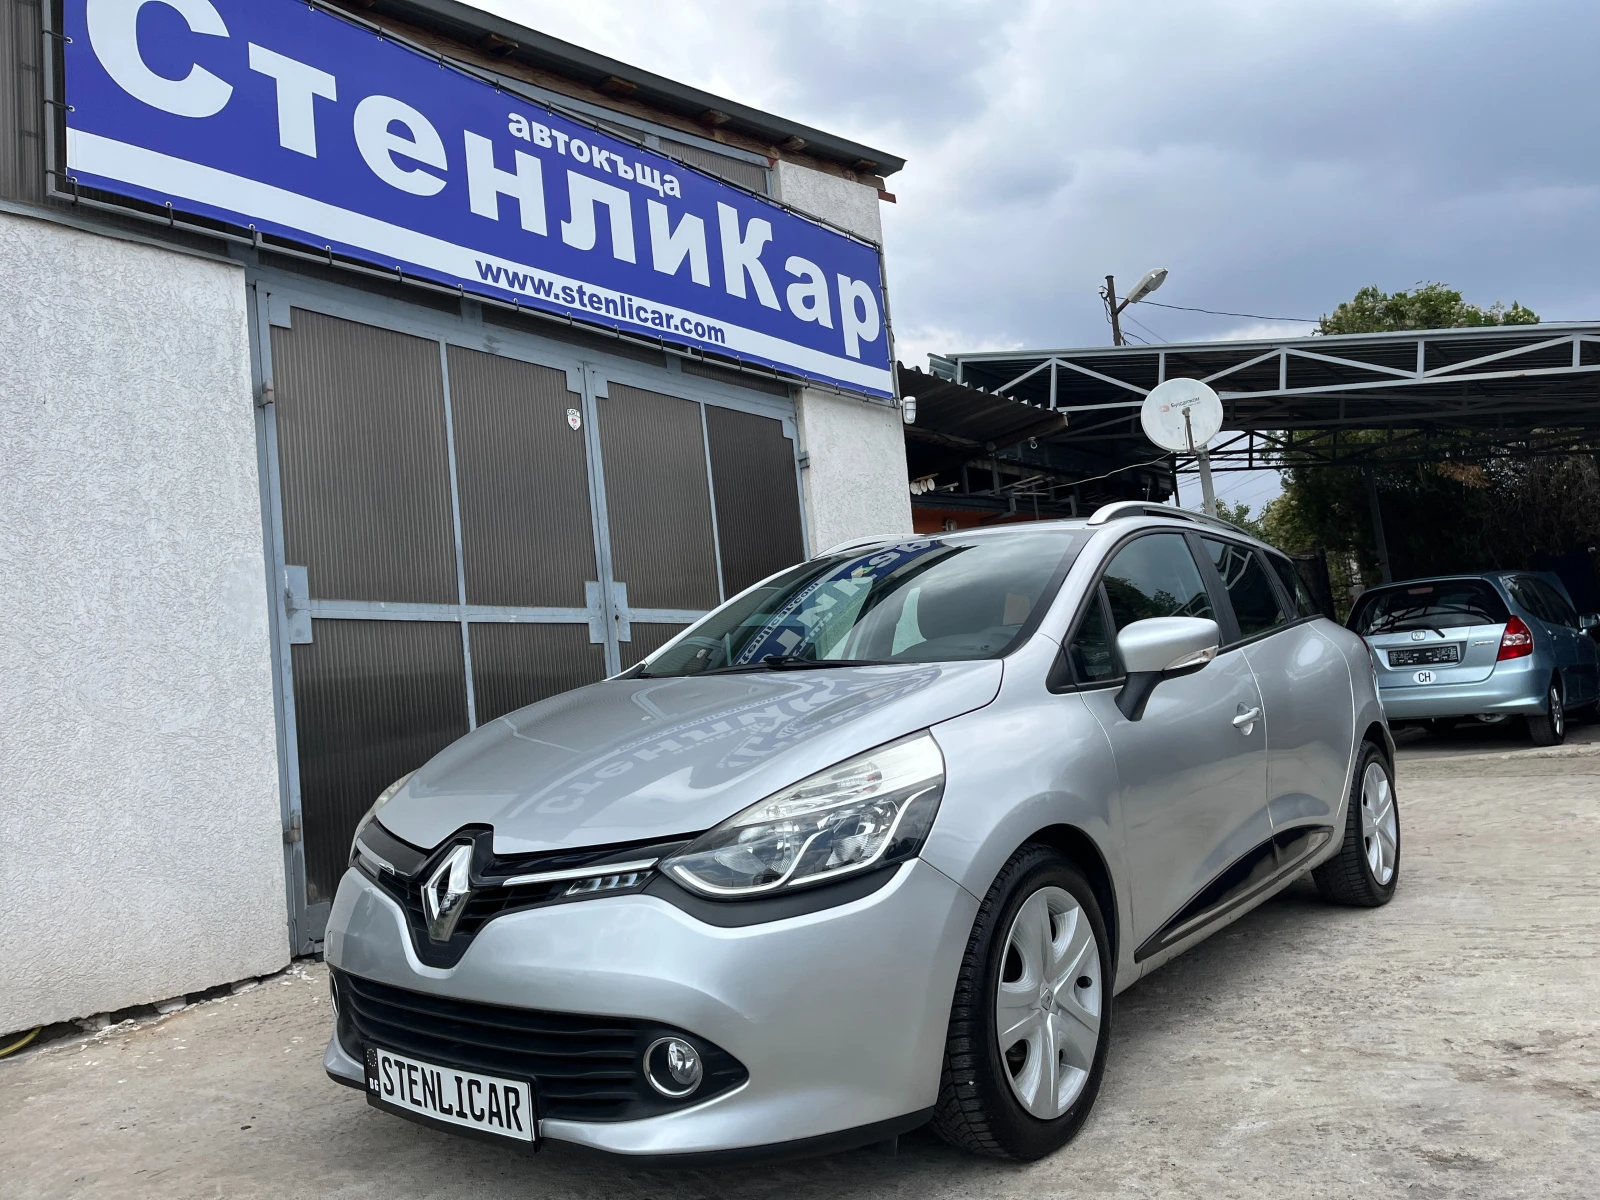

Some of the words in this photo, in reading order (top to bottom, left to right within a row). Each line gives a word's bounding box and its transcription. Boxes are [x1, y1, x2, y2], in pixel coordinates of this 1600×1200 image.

[86, 0, 881, 360] СтенлиКар
[507, 112, 682, 199] автокъща
[475, 259, 726, 345] www.stenlicar.com
[1418, 670, 1431, 683] CH
[369, 1077, 379, 1092] BG
[382, 1056, 523, 1132] STENLICAR
